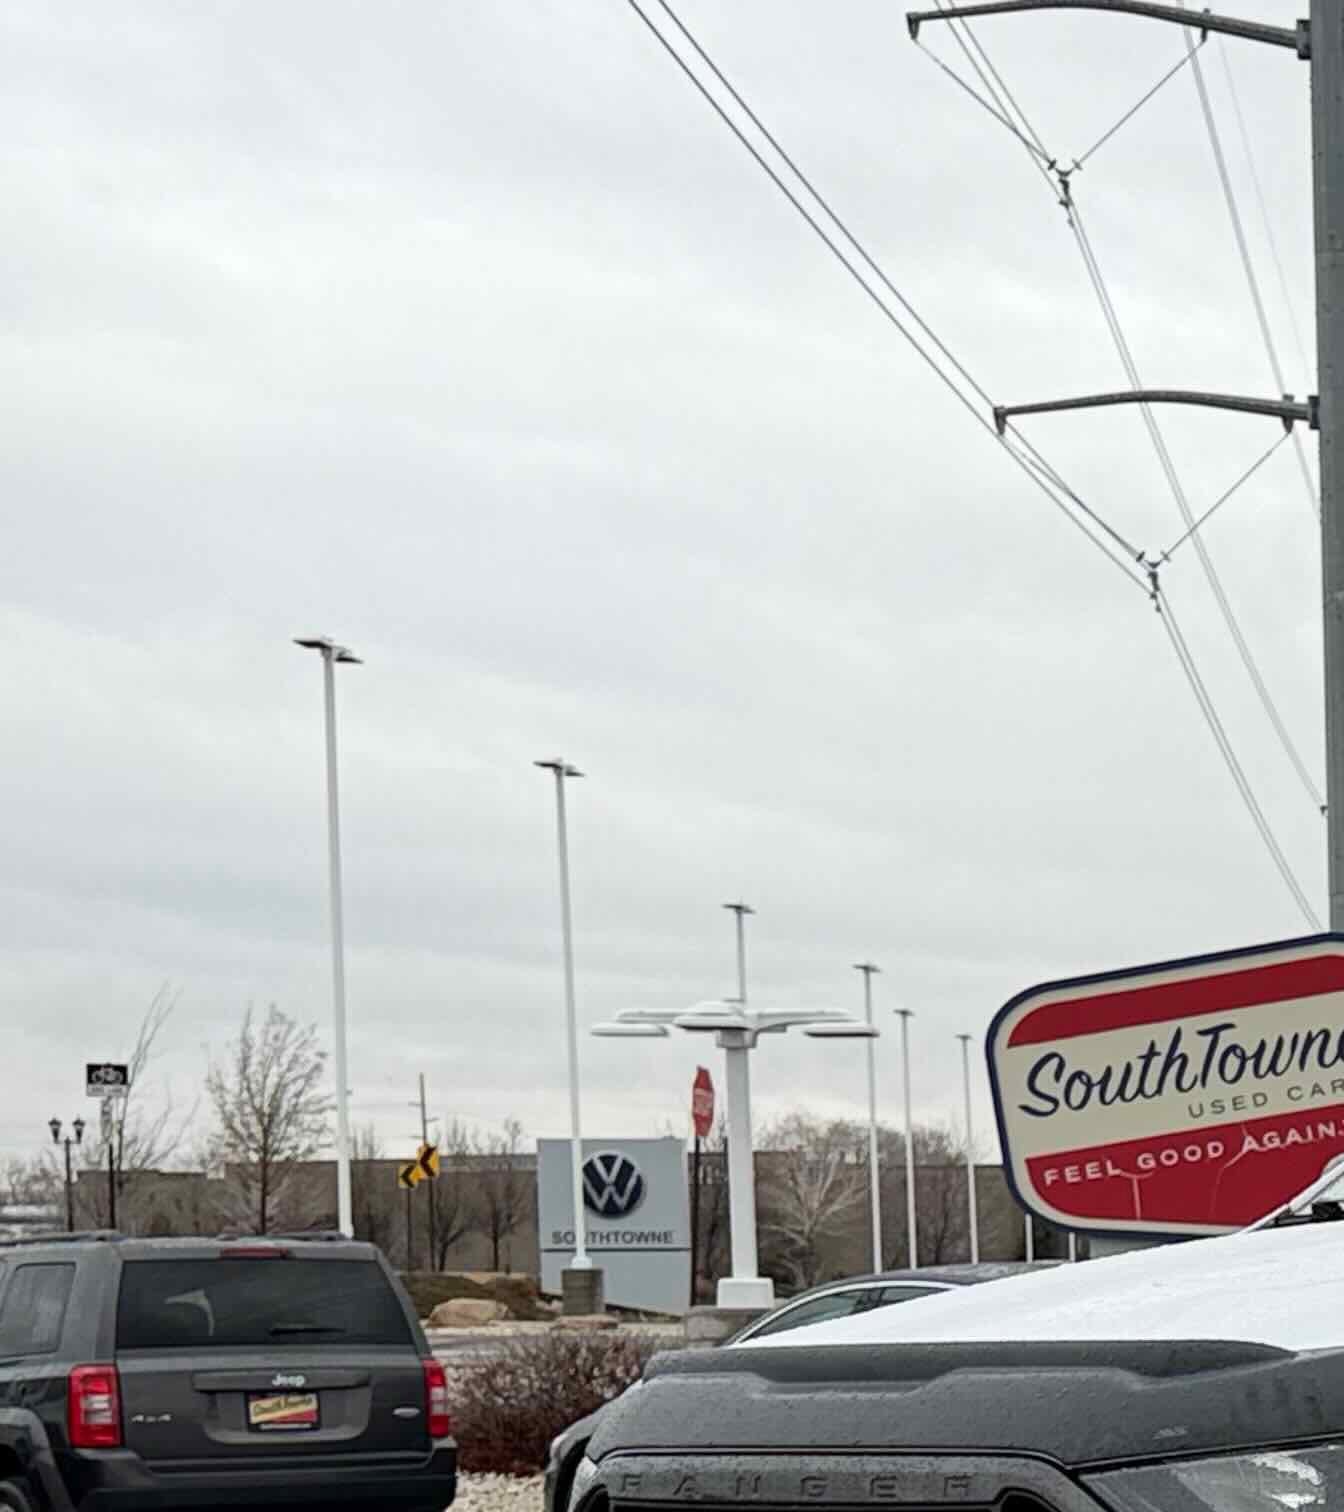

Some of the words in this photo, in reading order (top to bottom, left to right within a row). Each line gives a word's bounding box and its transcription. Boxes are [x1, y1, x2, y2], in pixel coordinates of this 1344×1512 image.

[1188, 1092, 1269, 1118] USED
[1043, 1160, 1122, 1185] FEEL
[1137, 1141, 1224, 1170] GOOD
[272, 1373, 306, 1387] Jeep
